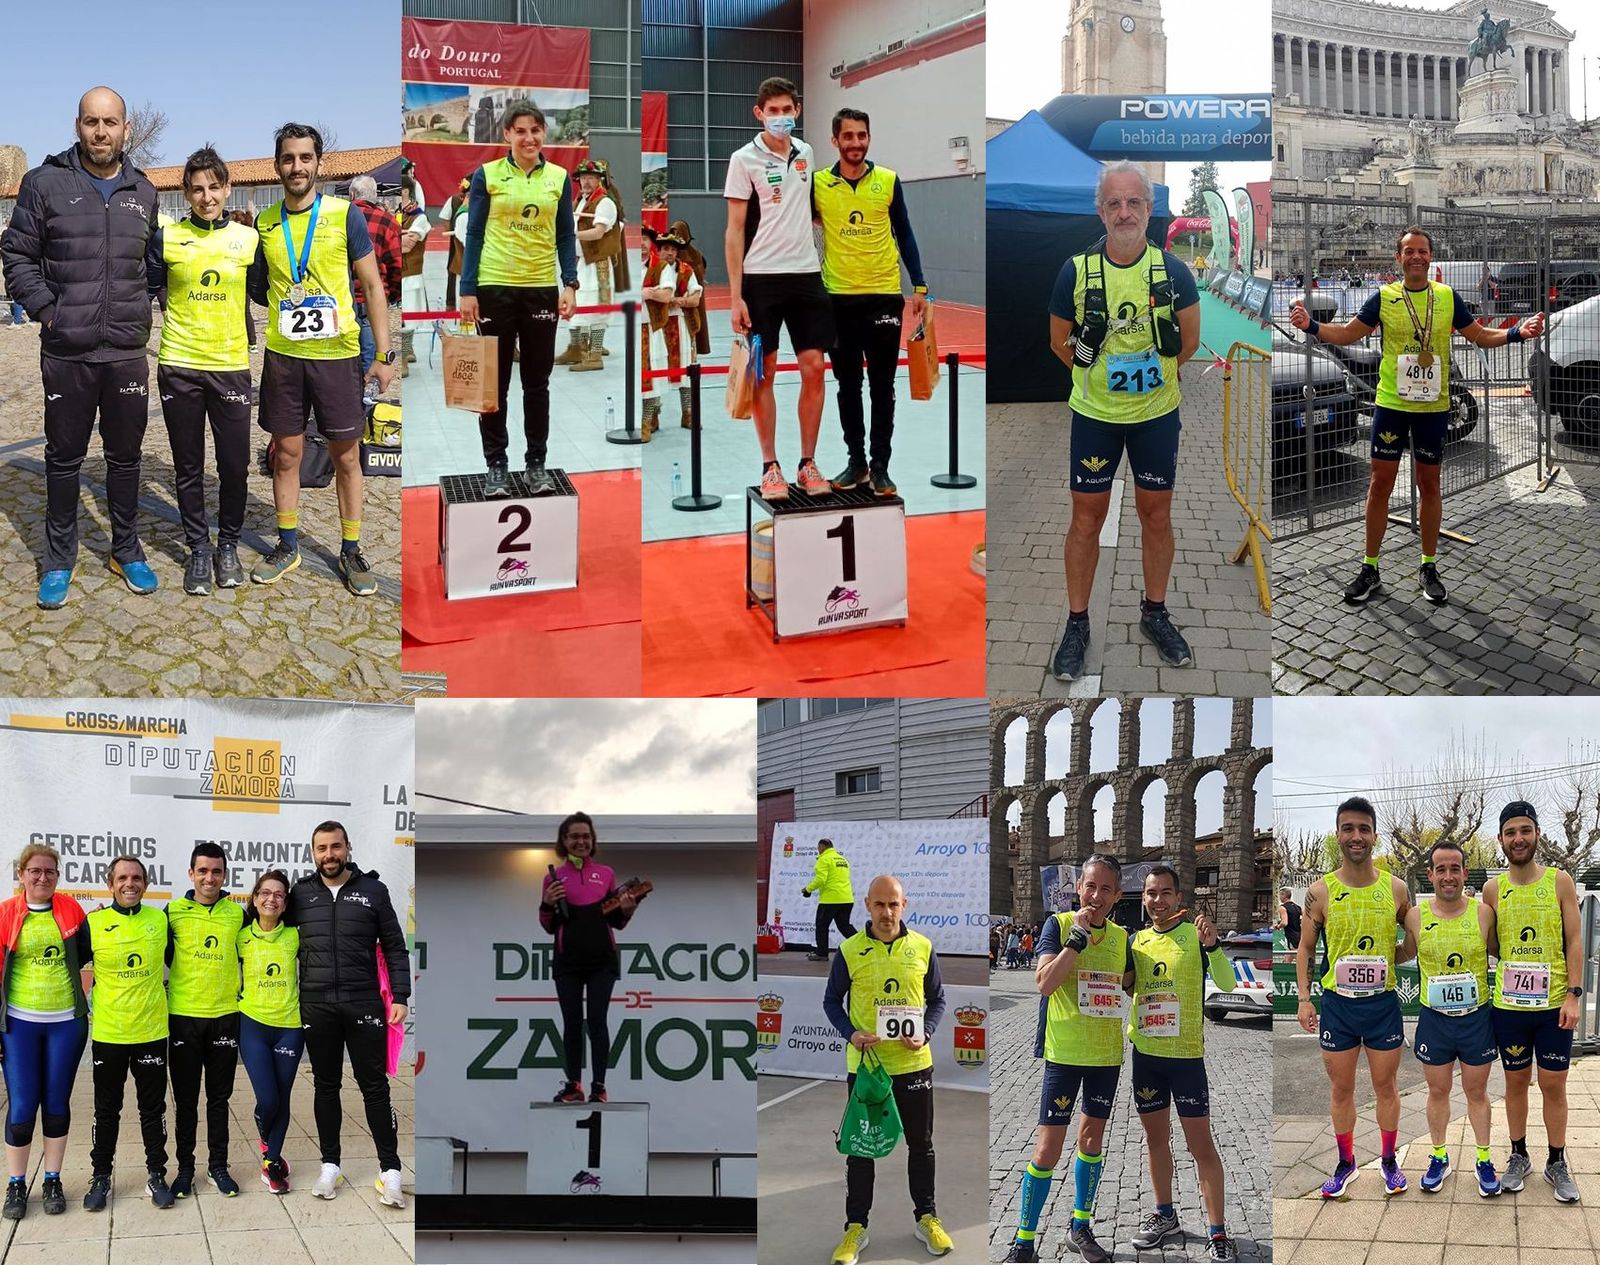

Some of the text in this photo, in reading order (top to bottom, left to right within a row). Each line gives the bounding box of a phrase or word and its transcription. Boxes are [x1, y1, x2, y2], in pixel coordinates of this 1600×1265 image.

[408, 44, 502, 63] do Douro
[440, 66, 501, 79] PORTUGAL
[1120, 99, 1271, 119] POWERA
[1121, 129, 1271, 148] bebida para depor
[509, 220, 544, 232] Adarsa
[840, 227, 872, 236] Adarsa
[188, 290, 226, 301] Adarsa
[291, 309, 324, 333] 23
[1111, 366, 1163, 392] 213
[1406, 365, 1434, 379] 4816
[368, 453, 402, 467] GIVOV
[497, 504, 532, 554] 2
[826, 515, 856, 582] 1
[65, 711, 188, 735] CROSS/MARCHA
[199, 772, 295, 798] ZAMORA
[383, 784, 408, 805] LA
[915, 842, 967, 857] Arroyo
[65, 861, 172, 886] CARAL
[906, 911, 959, 928] Arroyo
[193, 950, 224, 961] Adarsa
[1511, 946, 1543, 955] Adarsa
[31, 956, 64, 966] Adarsa
[117, 969, 149, 979] Adarsa
[1348, 968, 1375, 983] 356
[257, 978, 287, 988] Adarsa
[1145, 980, 1173, 990] Adarsa
[1514, 975, 1535, 991] 741
[1094, 994, 1112, 1006] 645
[1442, 987, 1464, 1002] 146
[873, 998, 908, 1007] Adarsa
[1145, 1015, 1165, 1026] 1545
[792, 1025, 843, 1038] AYUNTAMI
[886, 1018, 915, 1039] 90
[466, 1017, 757, 1082] ZAMOR
[828, 1039, 842, 1051] de
[576, 1111, 601, 1168] 1
